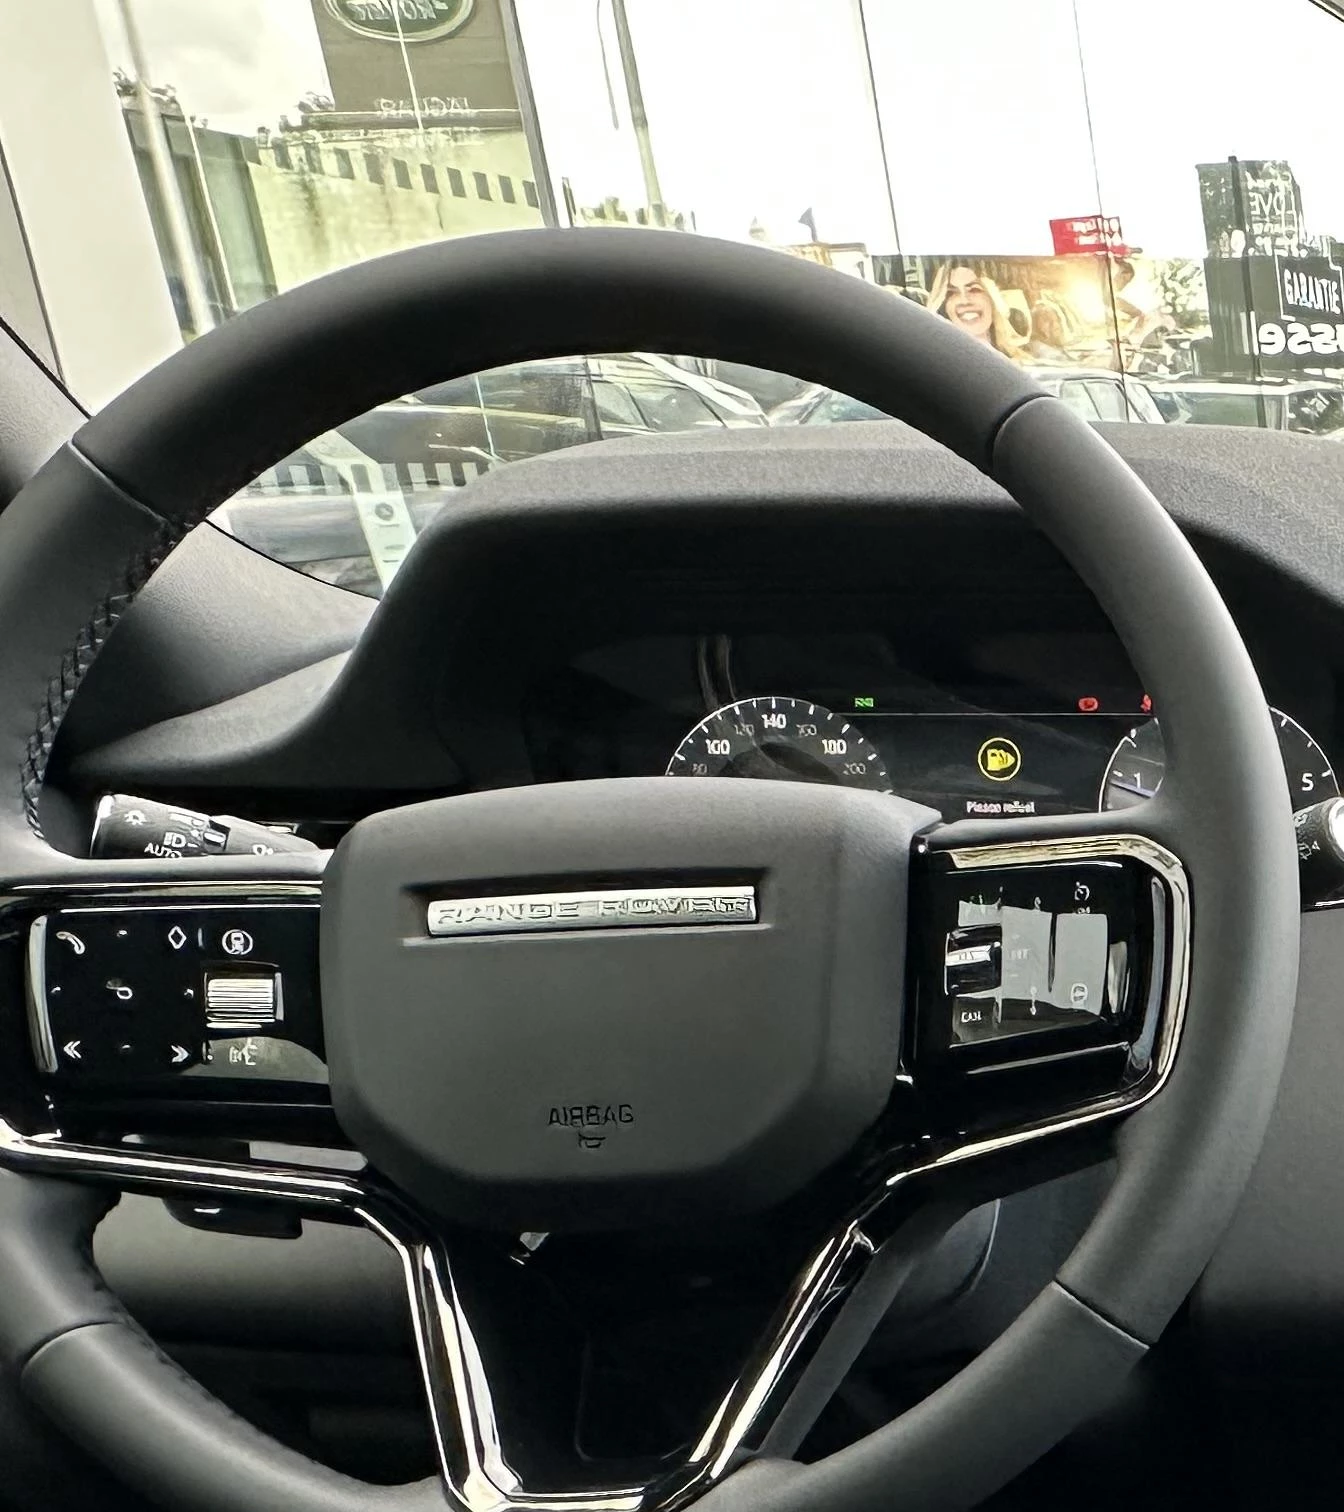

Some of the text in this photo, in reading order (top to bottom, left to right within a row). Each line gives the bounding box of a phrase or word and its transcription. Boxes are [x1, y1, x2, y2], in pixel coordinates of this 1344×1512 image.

[1301, 773, 1315, 792] 5
[438, 895, 750, 925] RANGE ROVER
[547, 1103, 634, 1127] AIRBAG
